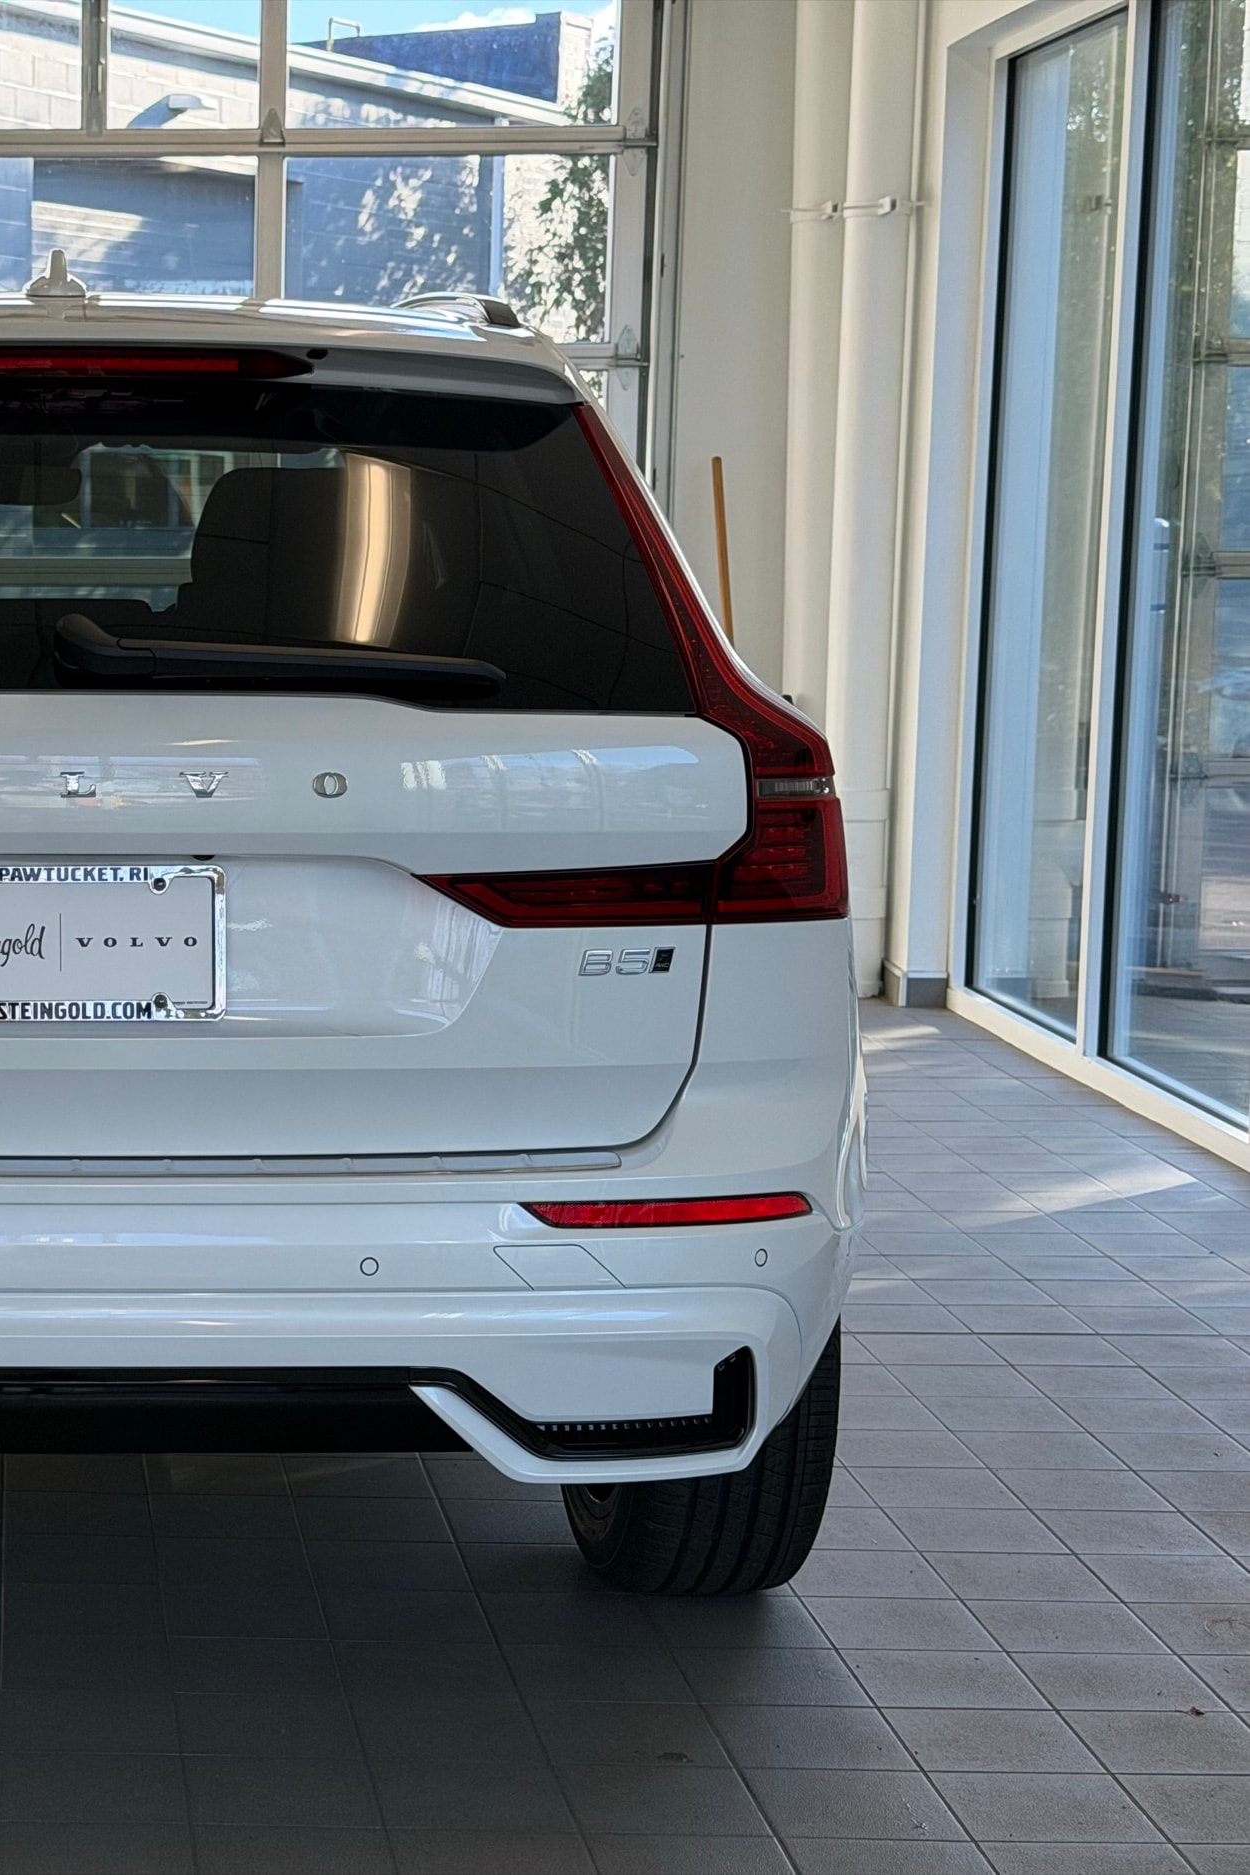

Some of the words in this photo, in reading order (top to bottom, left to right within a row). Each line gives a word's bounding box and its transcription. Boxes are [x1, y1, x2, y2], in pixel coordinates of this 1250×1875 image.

[130, 867, 149, 881] RI
[75, 935, 198, 948] VOLVO
[578, 948, 651, 976] B5
